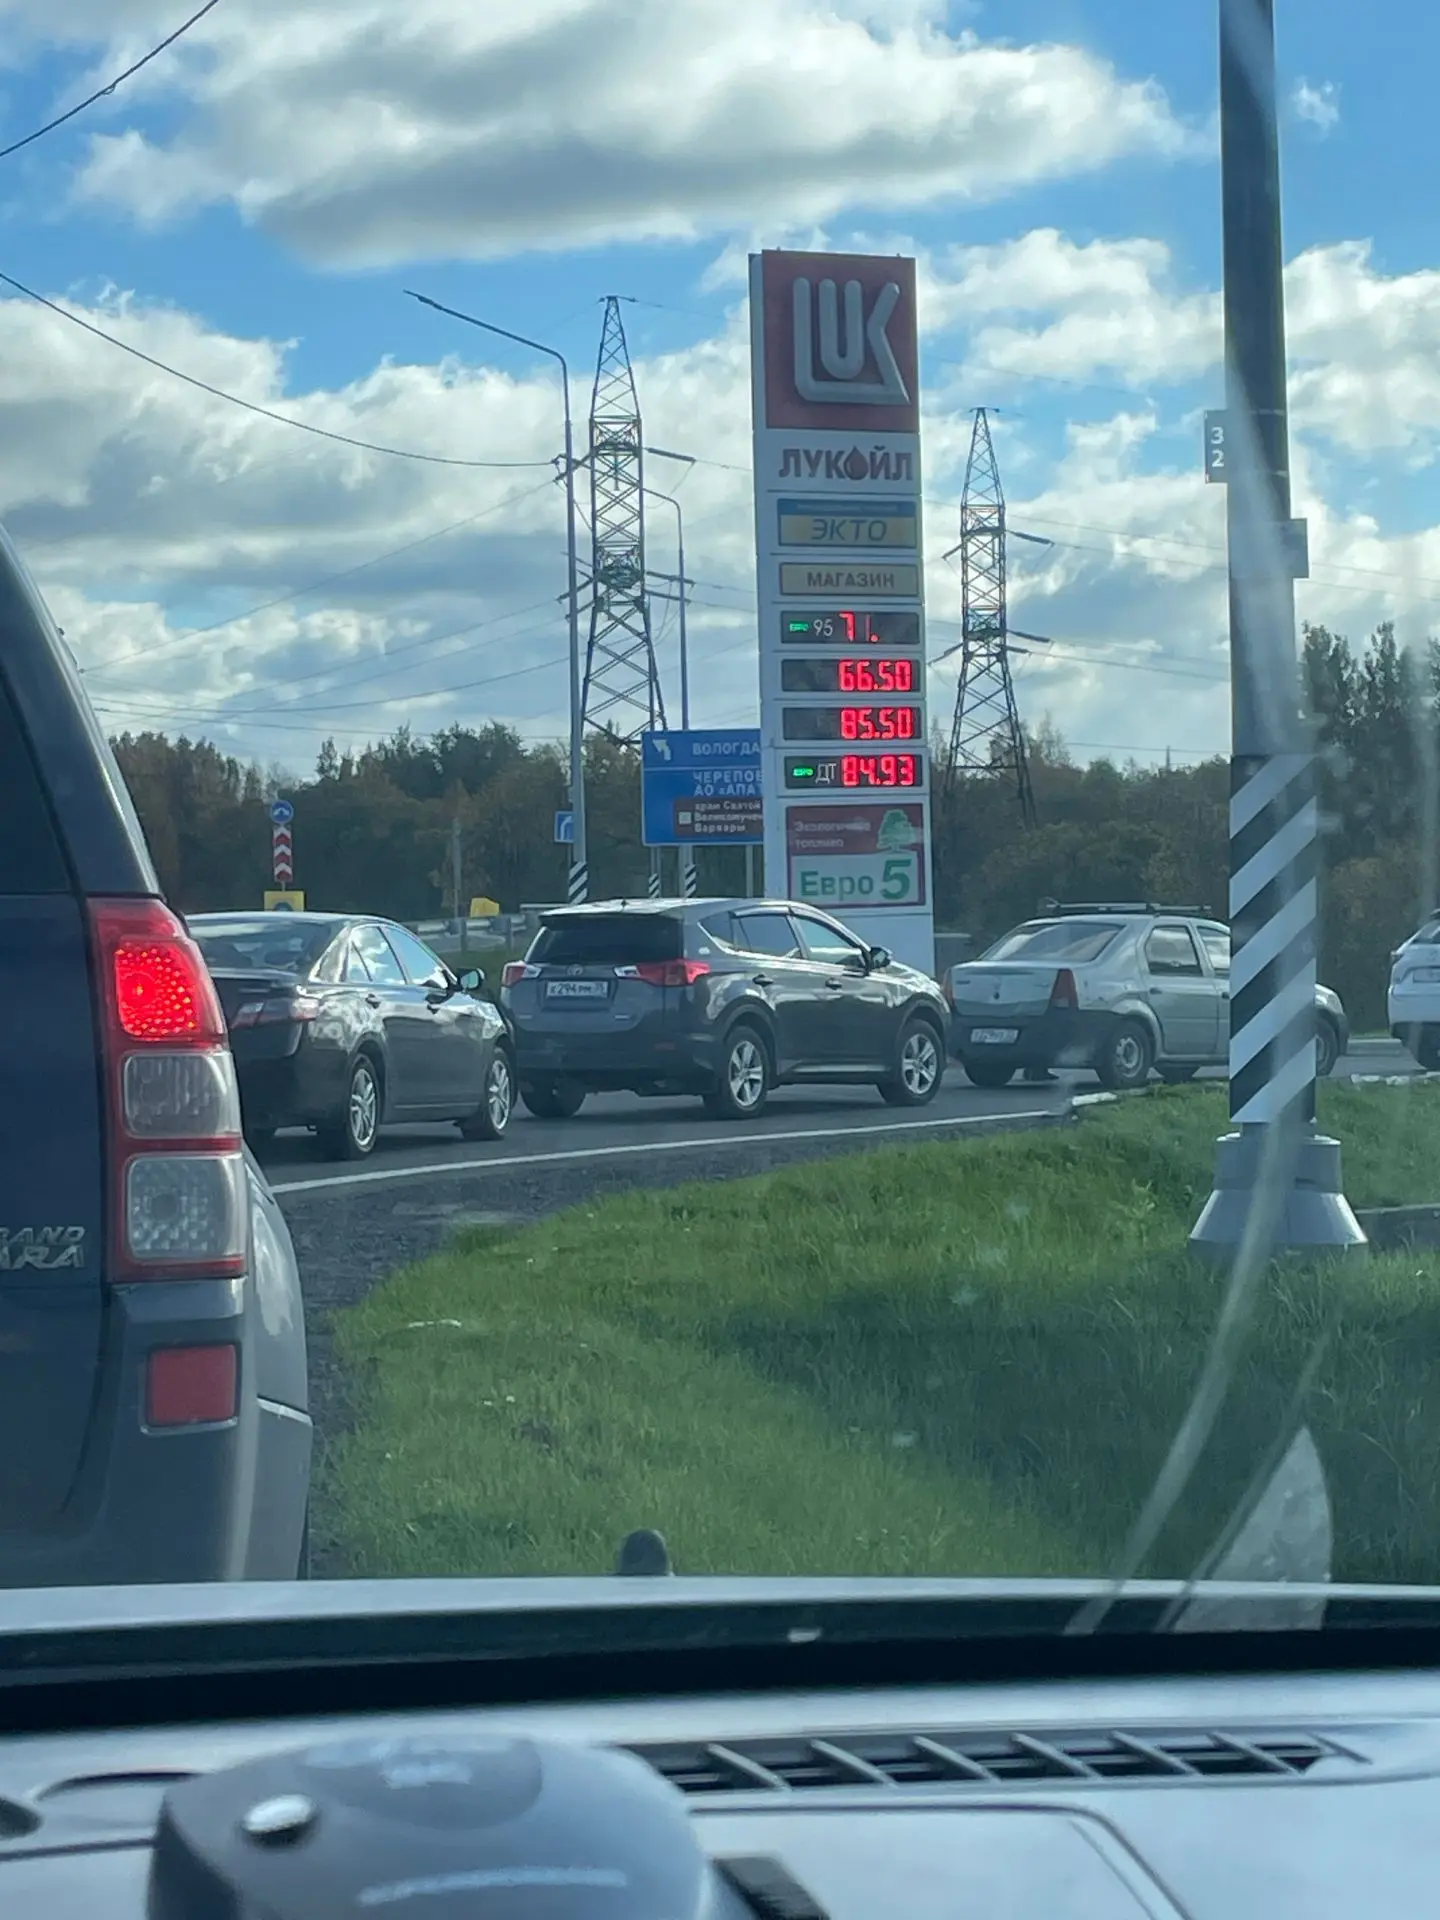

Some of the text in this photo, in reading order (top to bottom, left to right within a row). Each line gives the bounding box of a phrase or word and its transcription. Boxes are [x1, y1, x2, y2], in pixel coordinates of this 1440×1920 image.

[810, 518, 888, 542] ЭКТО
[806, 570, 895, 589] МАГАЗИН
[813, 619, 834, 638] 95
[838, 659, 913, 692] 66.50
[840, 707, 914, 741] 85.50
[692, 742, 761, 756] ВОЛОГДА
[814, 762, 837, 784] ДТ
[840, 754, 916, 787] 84.93
[693, 785, 714, 797] АО
[800, 859, 912, 901] Евро 5
